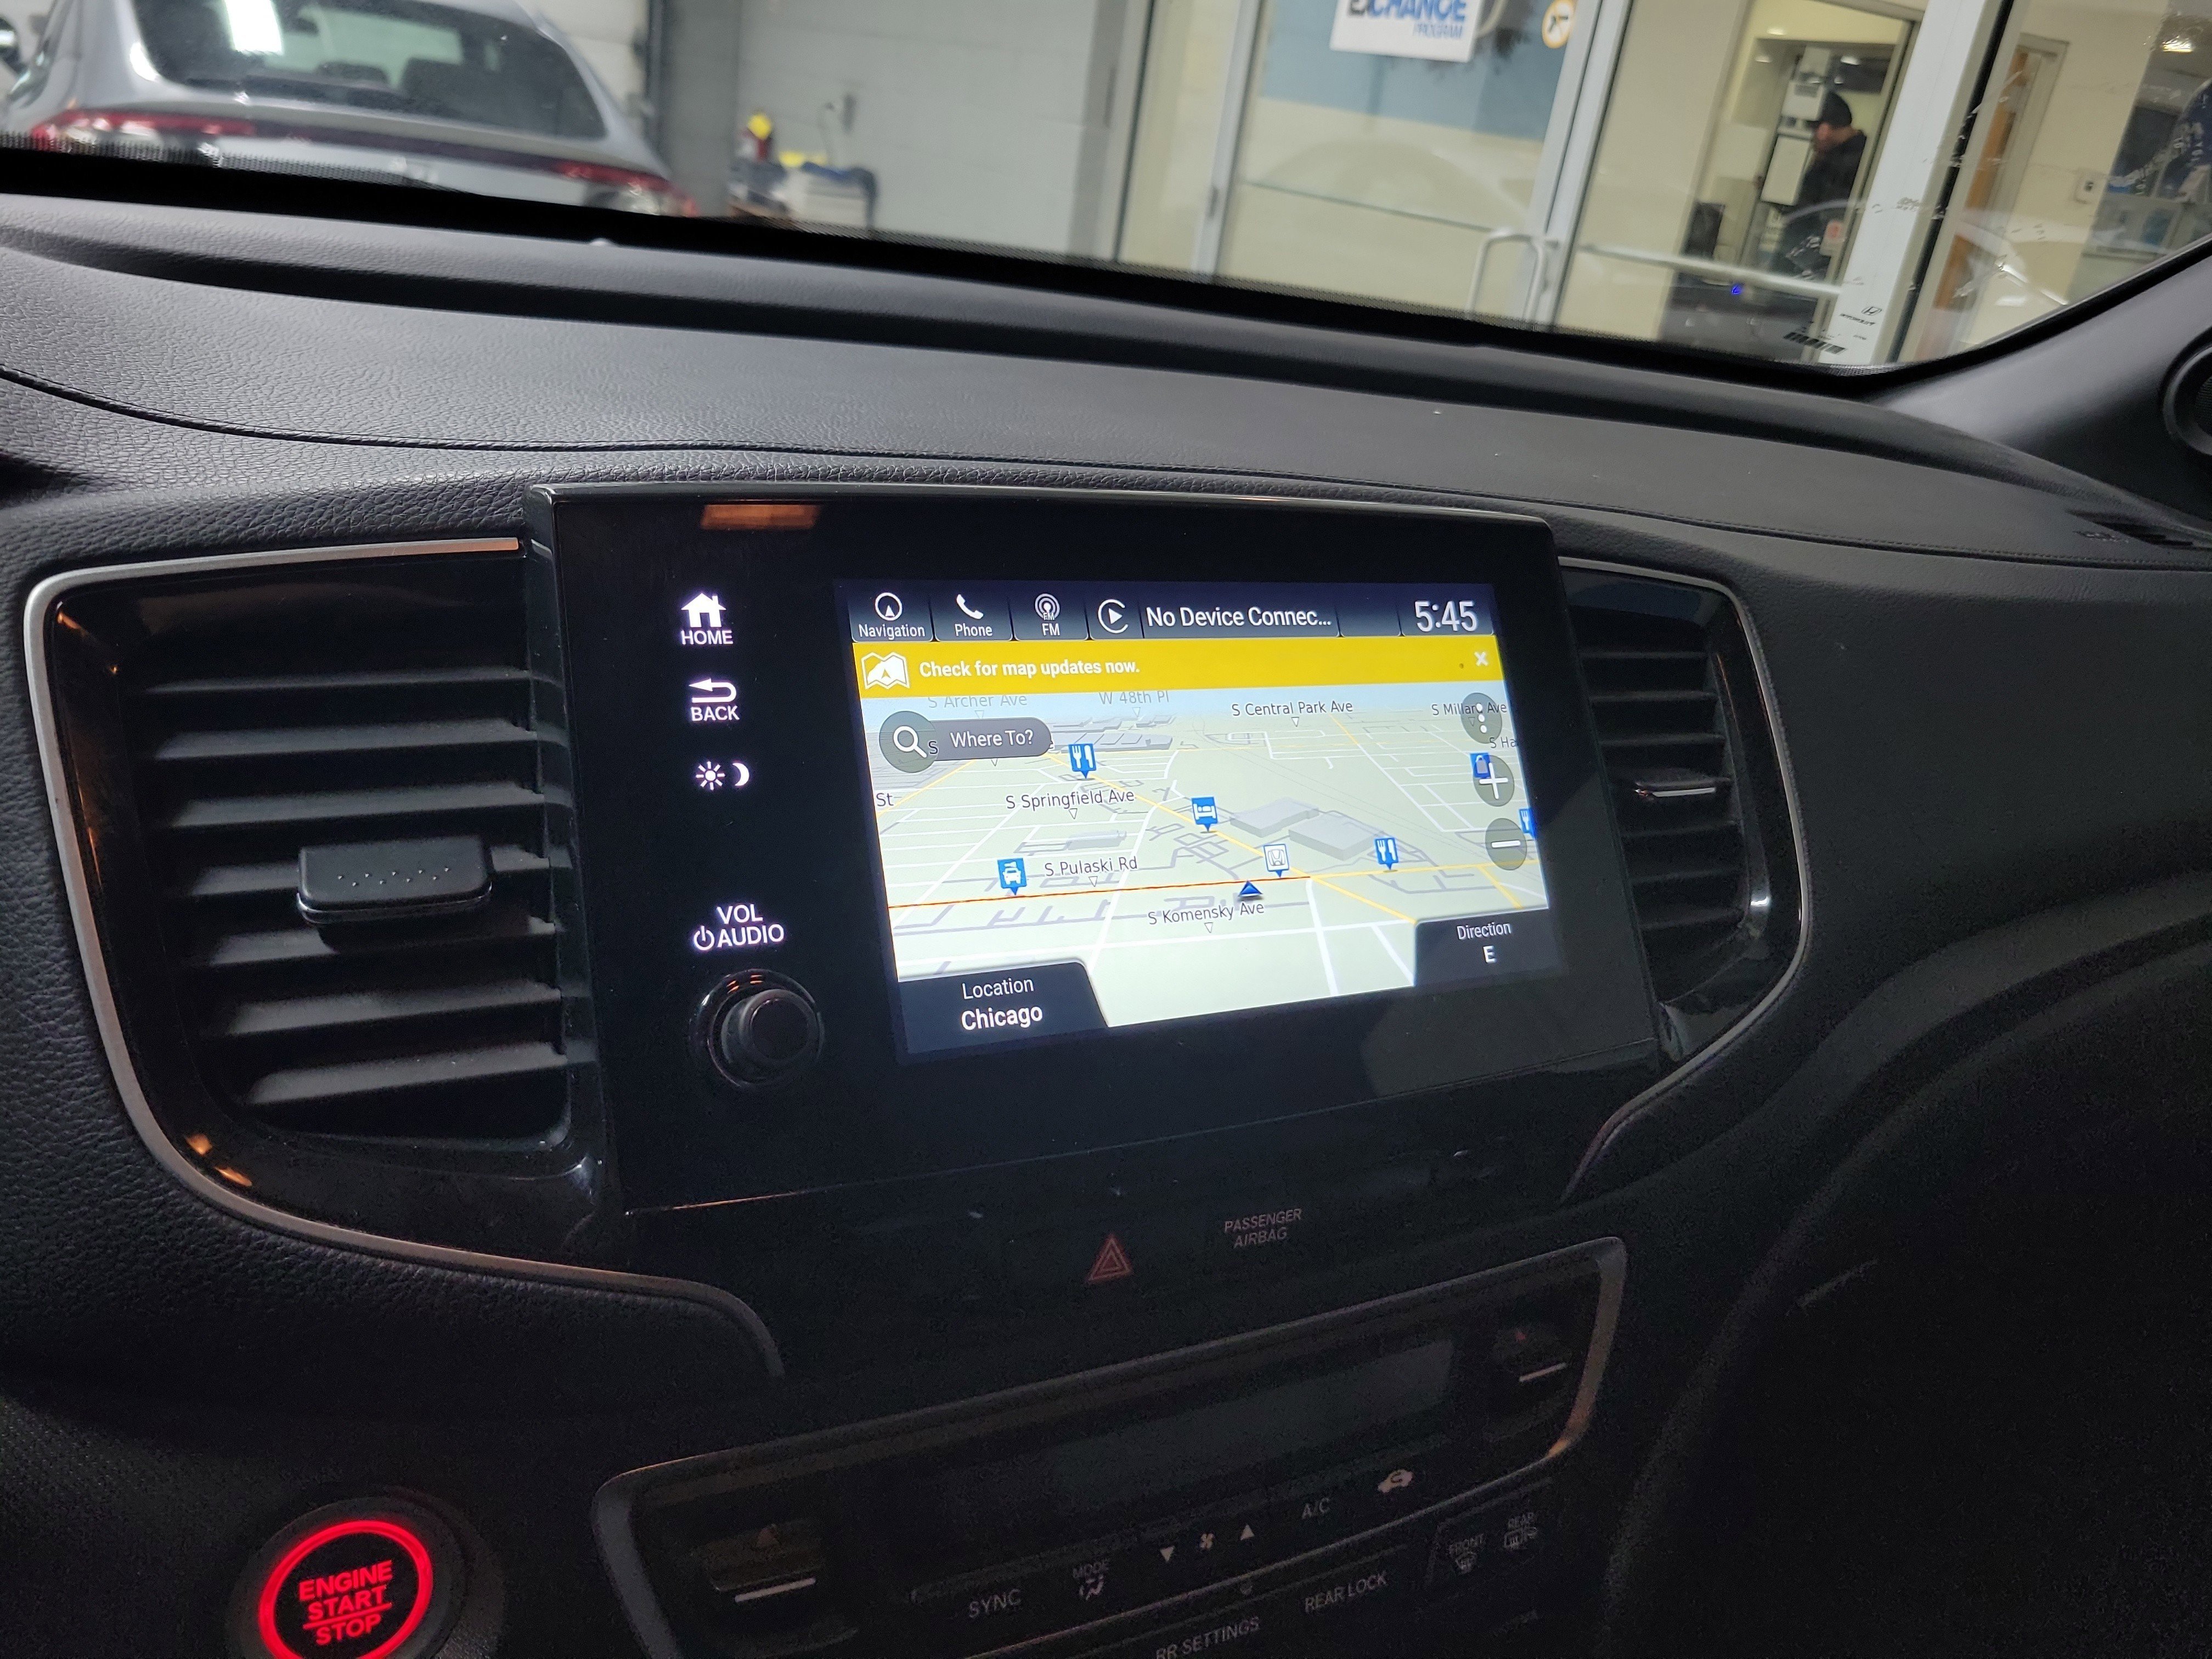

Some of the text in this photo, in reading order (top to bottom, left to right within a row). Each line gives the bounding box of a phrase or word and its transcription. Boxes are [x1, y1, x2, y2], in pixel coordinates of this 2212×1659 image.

[1147, 607, 1333, 628] No Device Connec...
[1414, 600, 1479, 633] 5:45
[681, 629, 734, 646] HOME
[859, 623, 926, 640] Navigation
[955, 623, 994, 637] Phone
[1042, 623, 1060, 636] FM
[919, 659, 1141, 679] Check for map updates now.
[928, 695, 1028, 708] S Archer Ave
[1098, 690, 1170, 706] W 48th Pl
[1232, 699, 1354, 716] S Central Park Ave
[691, 706, 741, 723] BACK
[1432, 704, 1439, 716] S
[1487, 702, 1508, 714] Ave
[928, 740, 939, 754] S
[950, 732, 1003, 748] Where
[1005, 729, 1034, 746] To?
[1489, 737, 1497, 749] S
[876, 792, 894, 808] St
[1006, 789, 1135, 812] S Springfield Ave
[1044, 856, 1138, 877] S Pulaski Rd
[716, 904, 764, 926] VOL
[1148, 902, 1265, 925] S Komensky Ave
[716, 923, 786, 949] AUDIO
[1456, 921, 1511, 941] Direction
[1483, 945, 1496, 963] E
[962, 977, 1035, 1000] Location
[961, 1004, 1043, 1031] Chicago
[1224, 1207, 1302, 1234] PASSENGER
[1233, 1227, 1288, 1250] AIRBAG
[1302, 1497, 1331, 1520] A/C
[298, 1559, 394, 1602] ENGINE
[307, 1583, 388, 1621] START
[1305, 1570, 1389, 1613] REAR LOCK
[968, 1589, 1022, 1618] SYNC
[316, 1612, 383, 1646] STOP
[1181, 1616, 1260, 1656] SETTINGS
